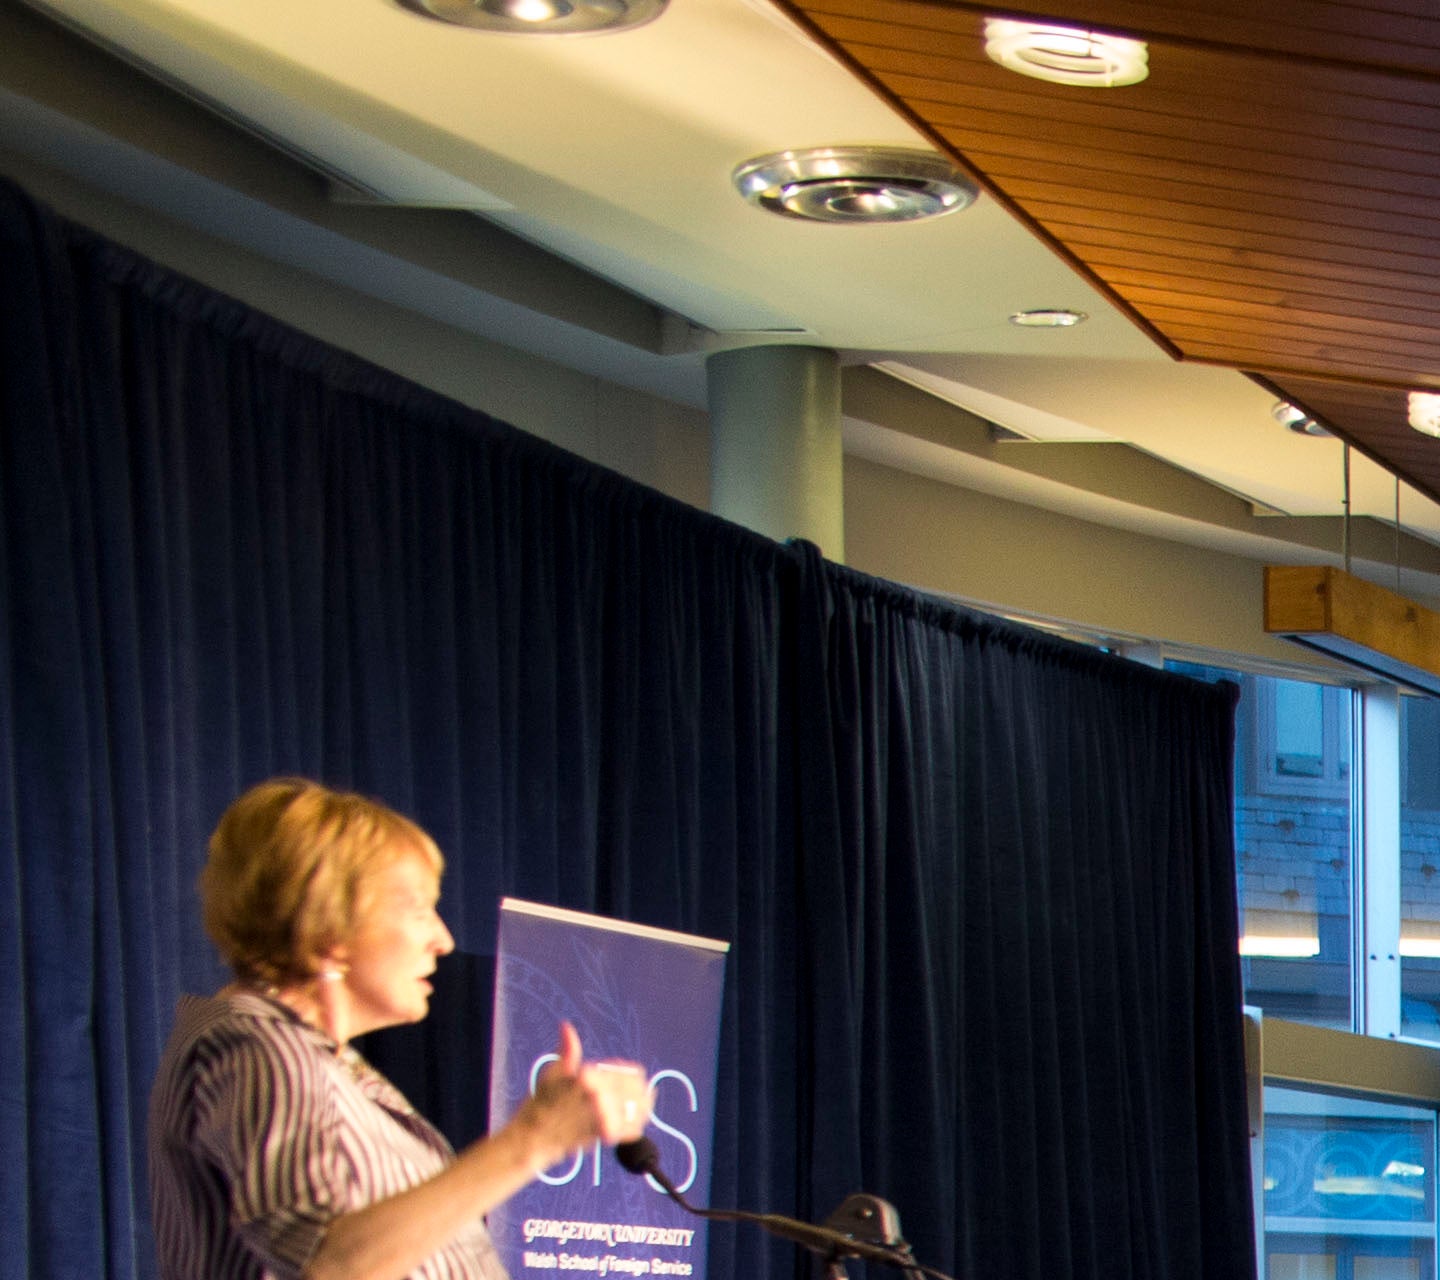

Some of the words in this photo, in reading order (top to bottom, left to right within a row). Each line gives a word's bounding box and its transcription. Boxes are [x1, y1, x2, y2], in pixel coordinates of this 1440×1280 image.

[613, 1223, 695, 1247] UNIVERSITY
[523, 1252, 557, 1269] Walsh
[559, 1252, 599, 1271] School
[608, 1256, 650, 1277] Foreign
[651, 1258, 692, 1276] Service
